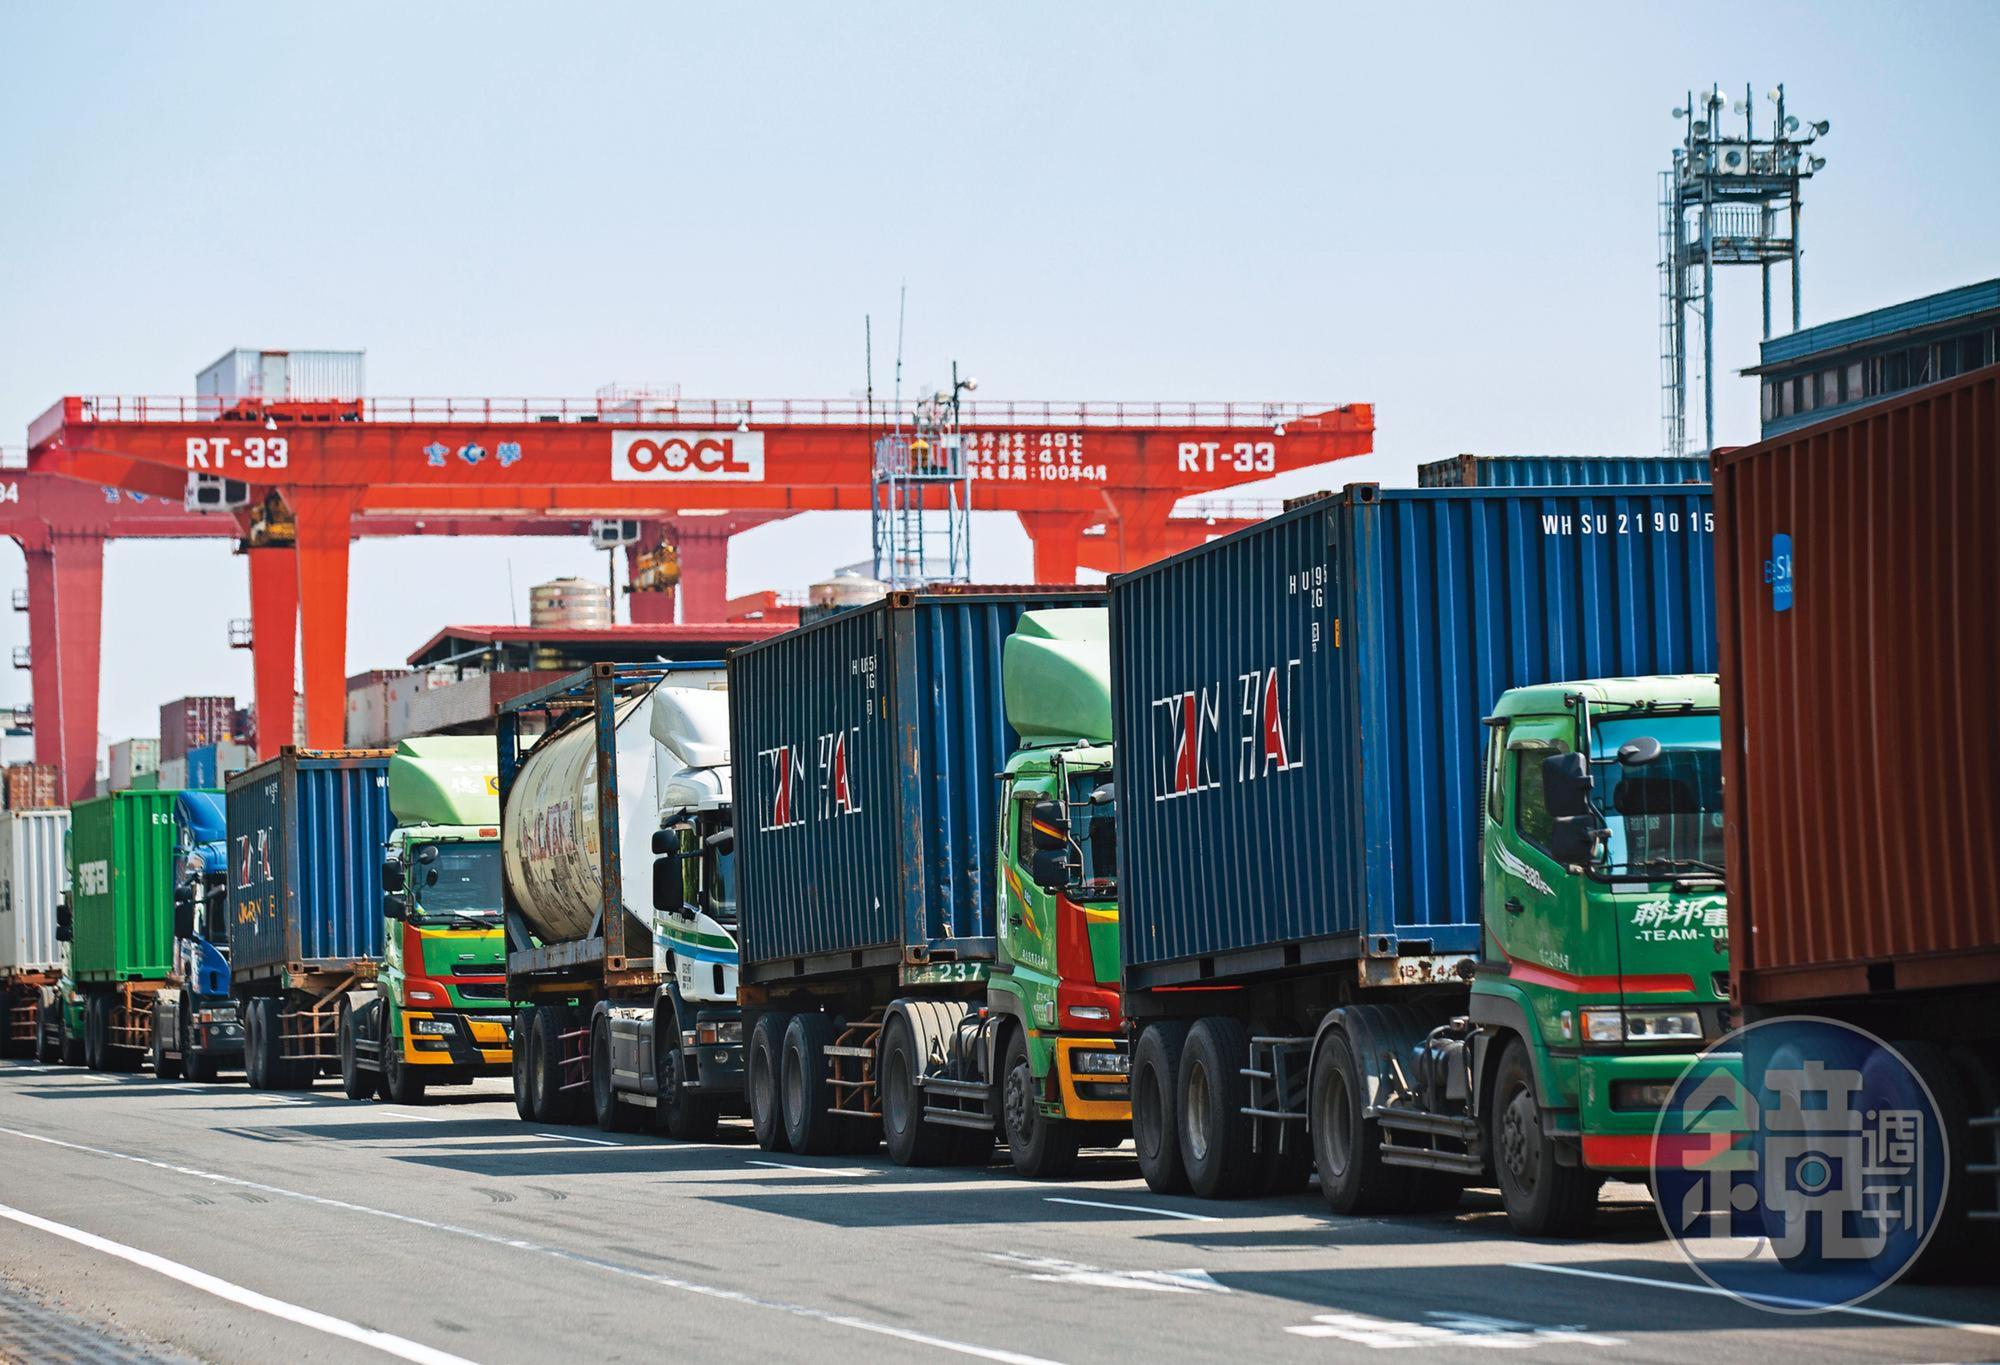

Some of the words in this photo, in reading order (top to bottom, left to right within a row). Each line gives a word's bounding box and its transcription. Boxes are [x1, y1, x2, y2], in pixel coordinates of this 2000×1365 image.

[186, 437, 288, 469] RT-33
[628, 438, 750, 473] OOCL
[1178, 442, 1276, 472] RT-33
[1710, 927, 1729, 939] U
[939, 963, 982, 983] 237
